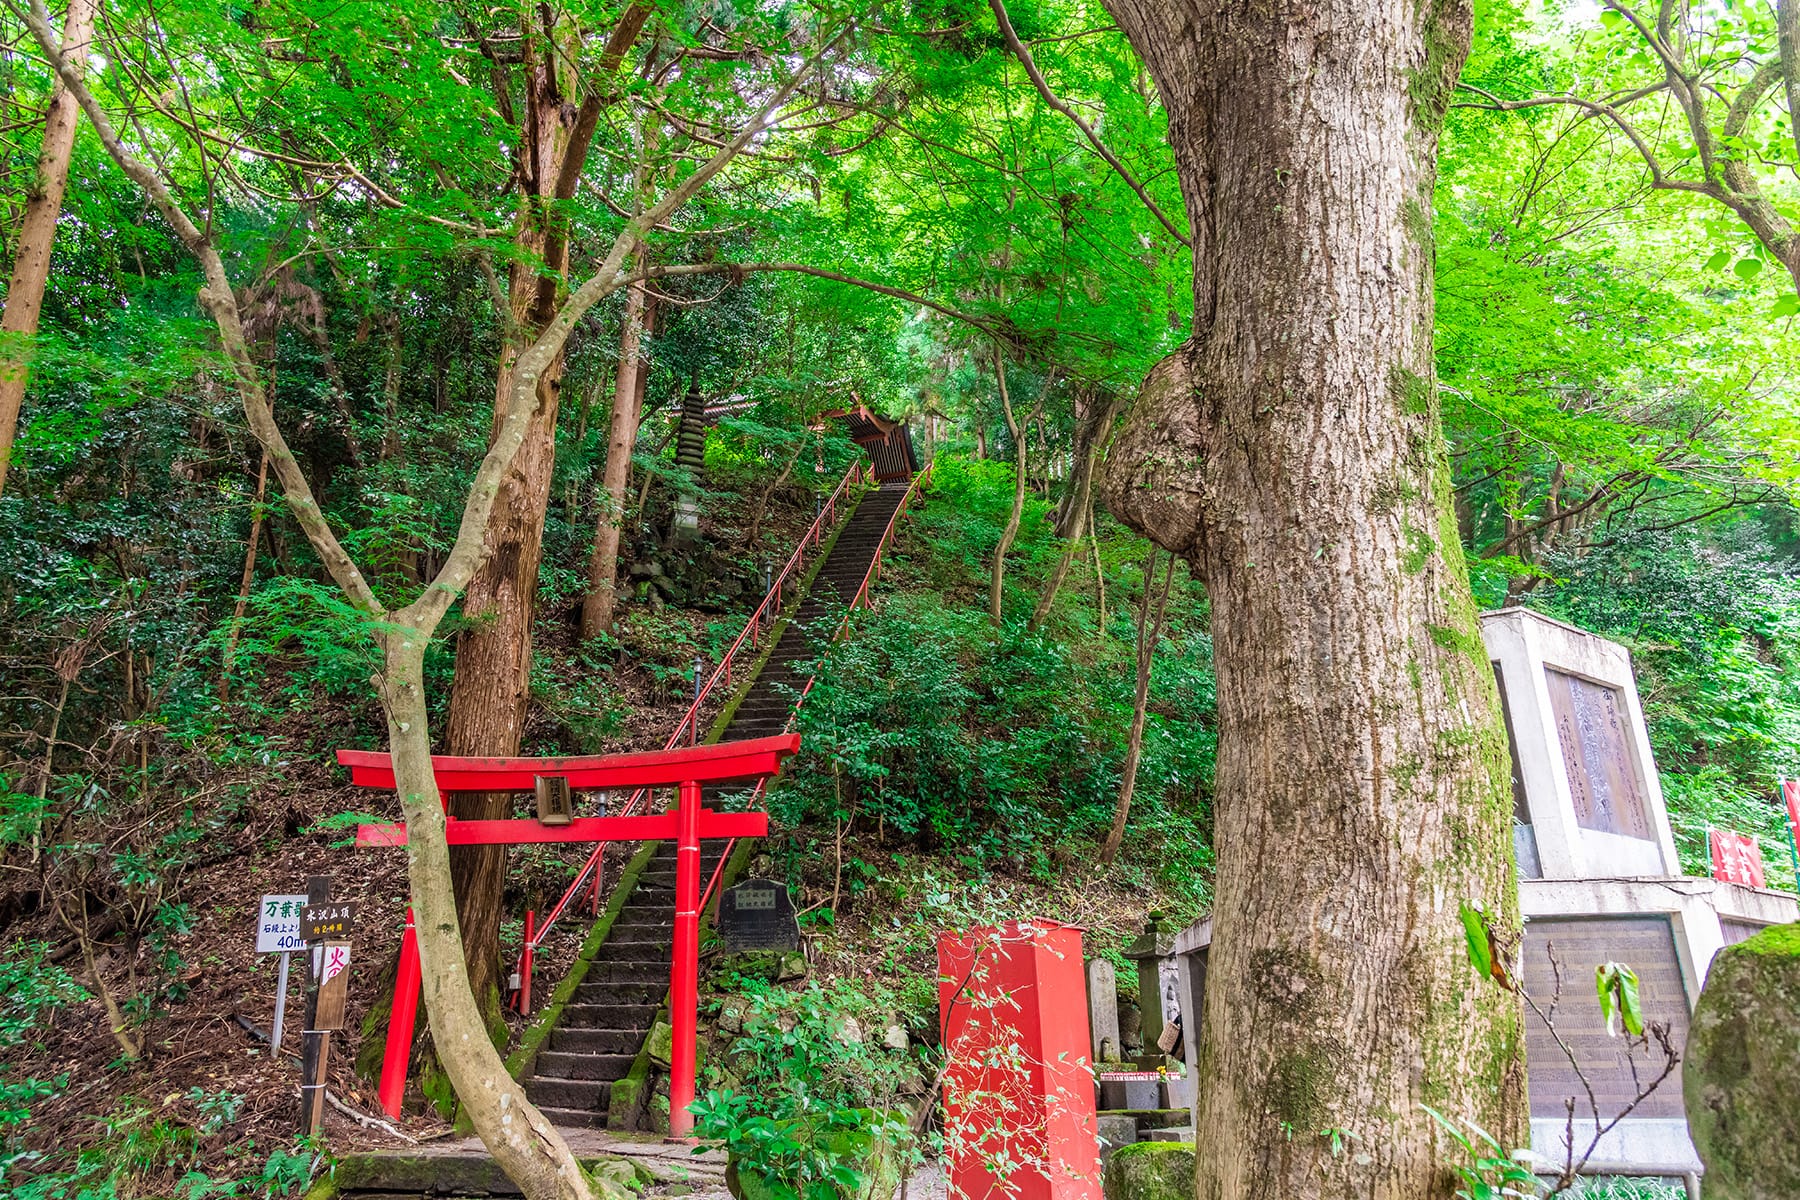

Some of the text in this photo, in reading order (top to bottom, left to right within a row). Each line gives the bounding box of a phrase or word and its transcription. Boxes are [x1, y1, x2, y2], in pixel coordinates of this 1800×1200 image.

[265, 901, 305, 919] 万葉歌
[307, 906, 350, 922] 水沢山頂
[277, 935, 304, 948] 40m
